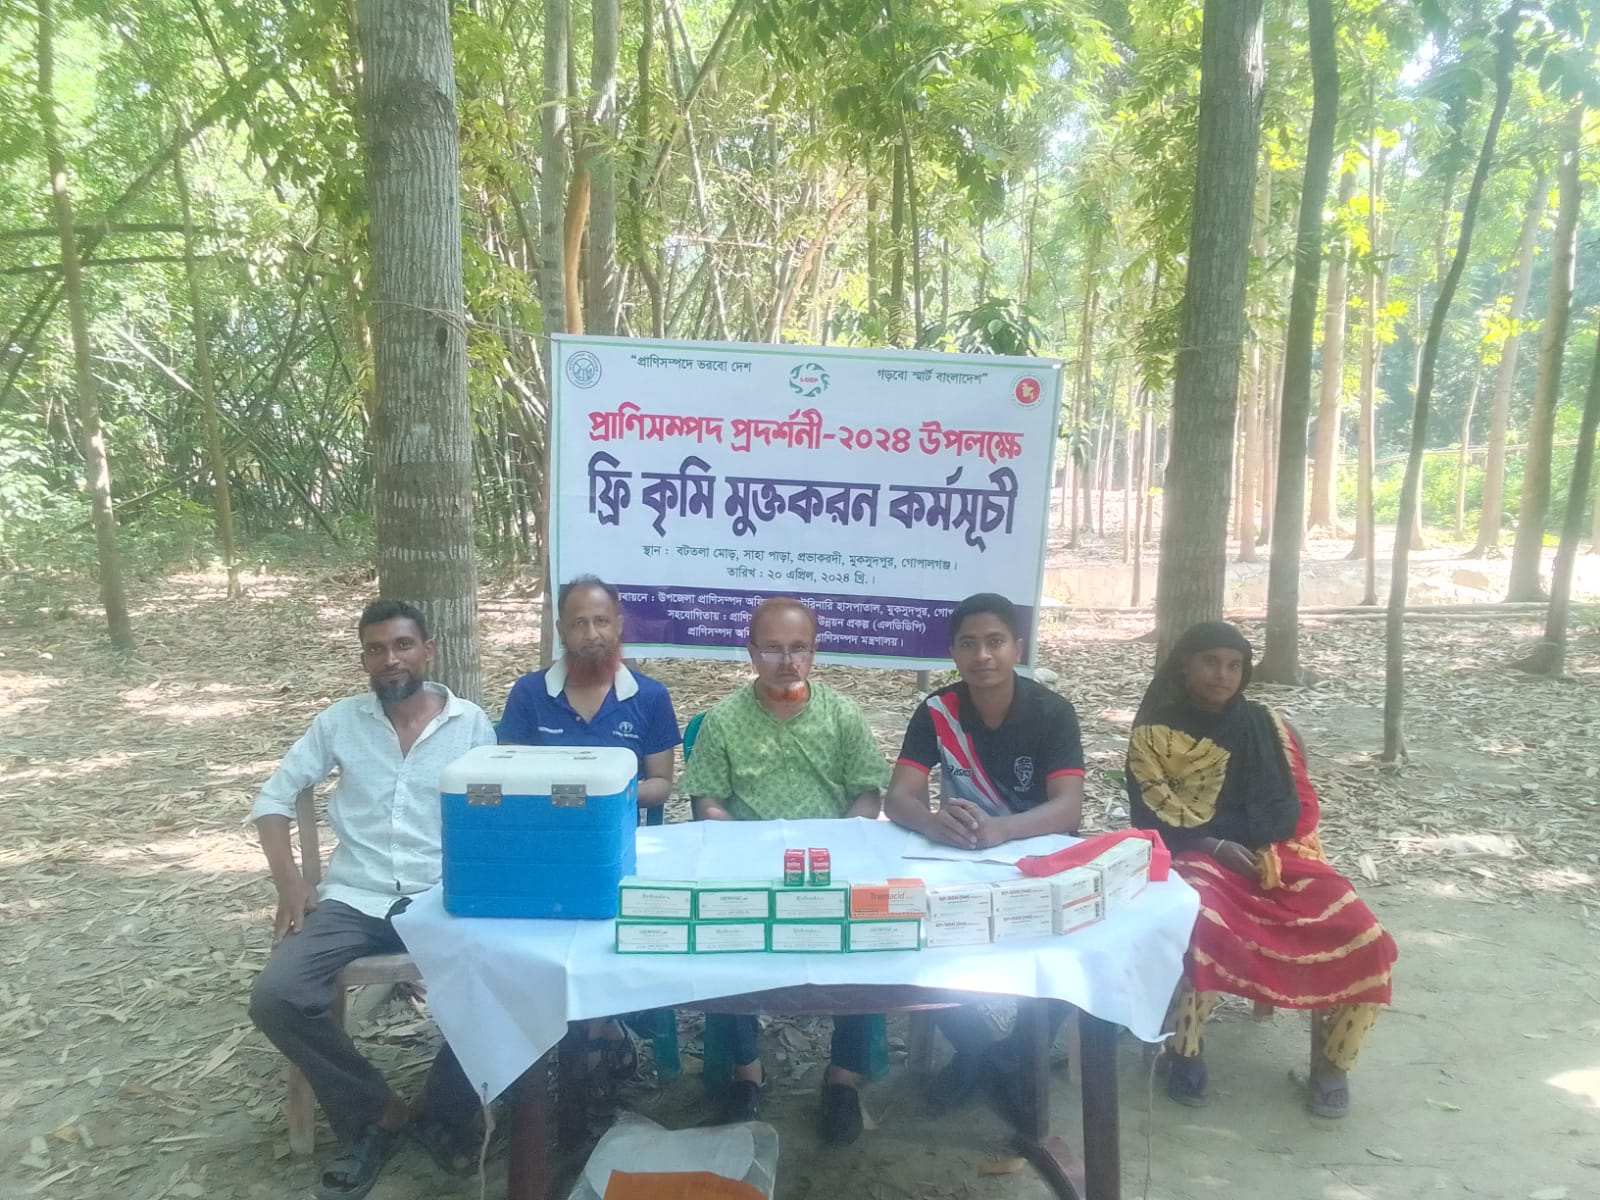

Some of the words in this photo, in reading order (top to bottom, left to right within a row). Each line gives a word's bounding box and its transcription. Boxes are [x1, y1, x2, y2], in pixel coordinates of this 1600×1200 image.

[697, 359, 727, 372] ভরবো
[731, 361, 752, 373] দেশ
[877, 369, 908, 382] গড়বো
[912, 368, 934, 382] স্মার্ট
[588, 401, 724, 443] প্রাণিসম্পদ
[731, 408, 911, 453] প্রদর্শনী-২০২৪
[919, 421, 1024, 464] উপলক্ষে
[588, 450, 632, 526] ফ্রি
[641, 456, 716, 538] কৃমি
[725, 476, 881, 537] মুক্তকরন
[889, 466, 1018, 552] কর্মসূচী
[676, 544, 710, 558] বটতলা
[743, 550, 764, 561] সাহা
[768, 570, 782, 580] ২০
[821, 572, 849, 584] ২০২৪
[658, 591, 696, 604] উপজেলা
[698, 593, 743, 605] প্রাণিসম্পদ
[687, 624, 733, 637] প্রাণিসম্পদ
